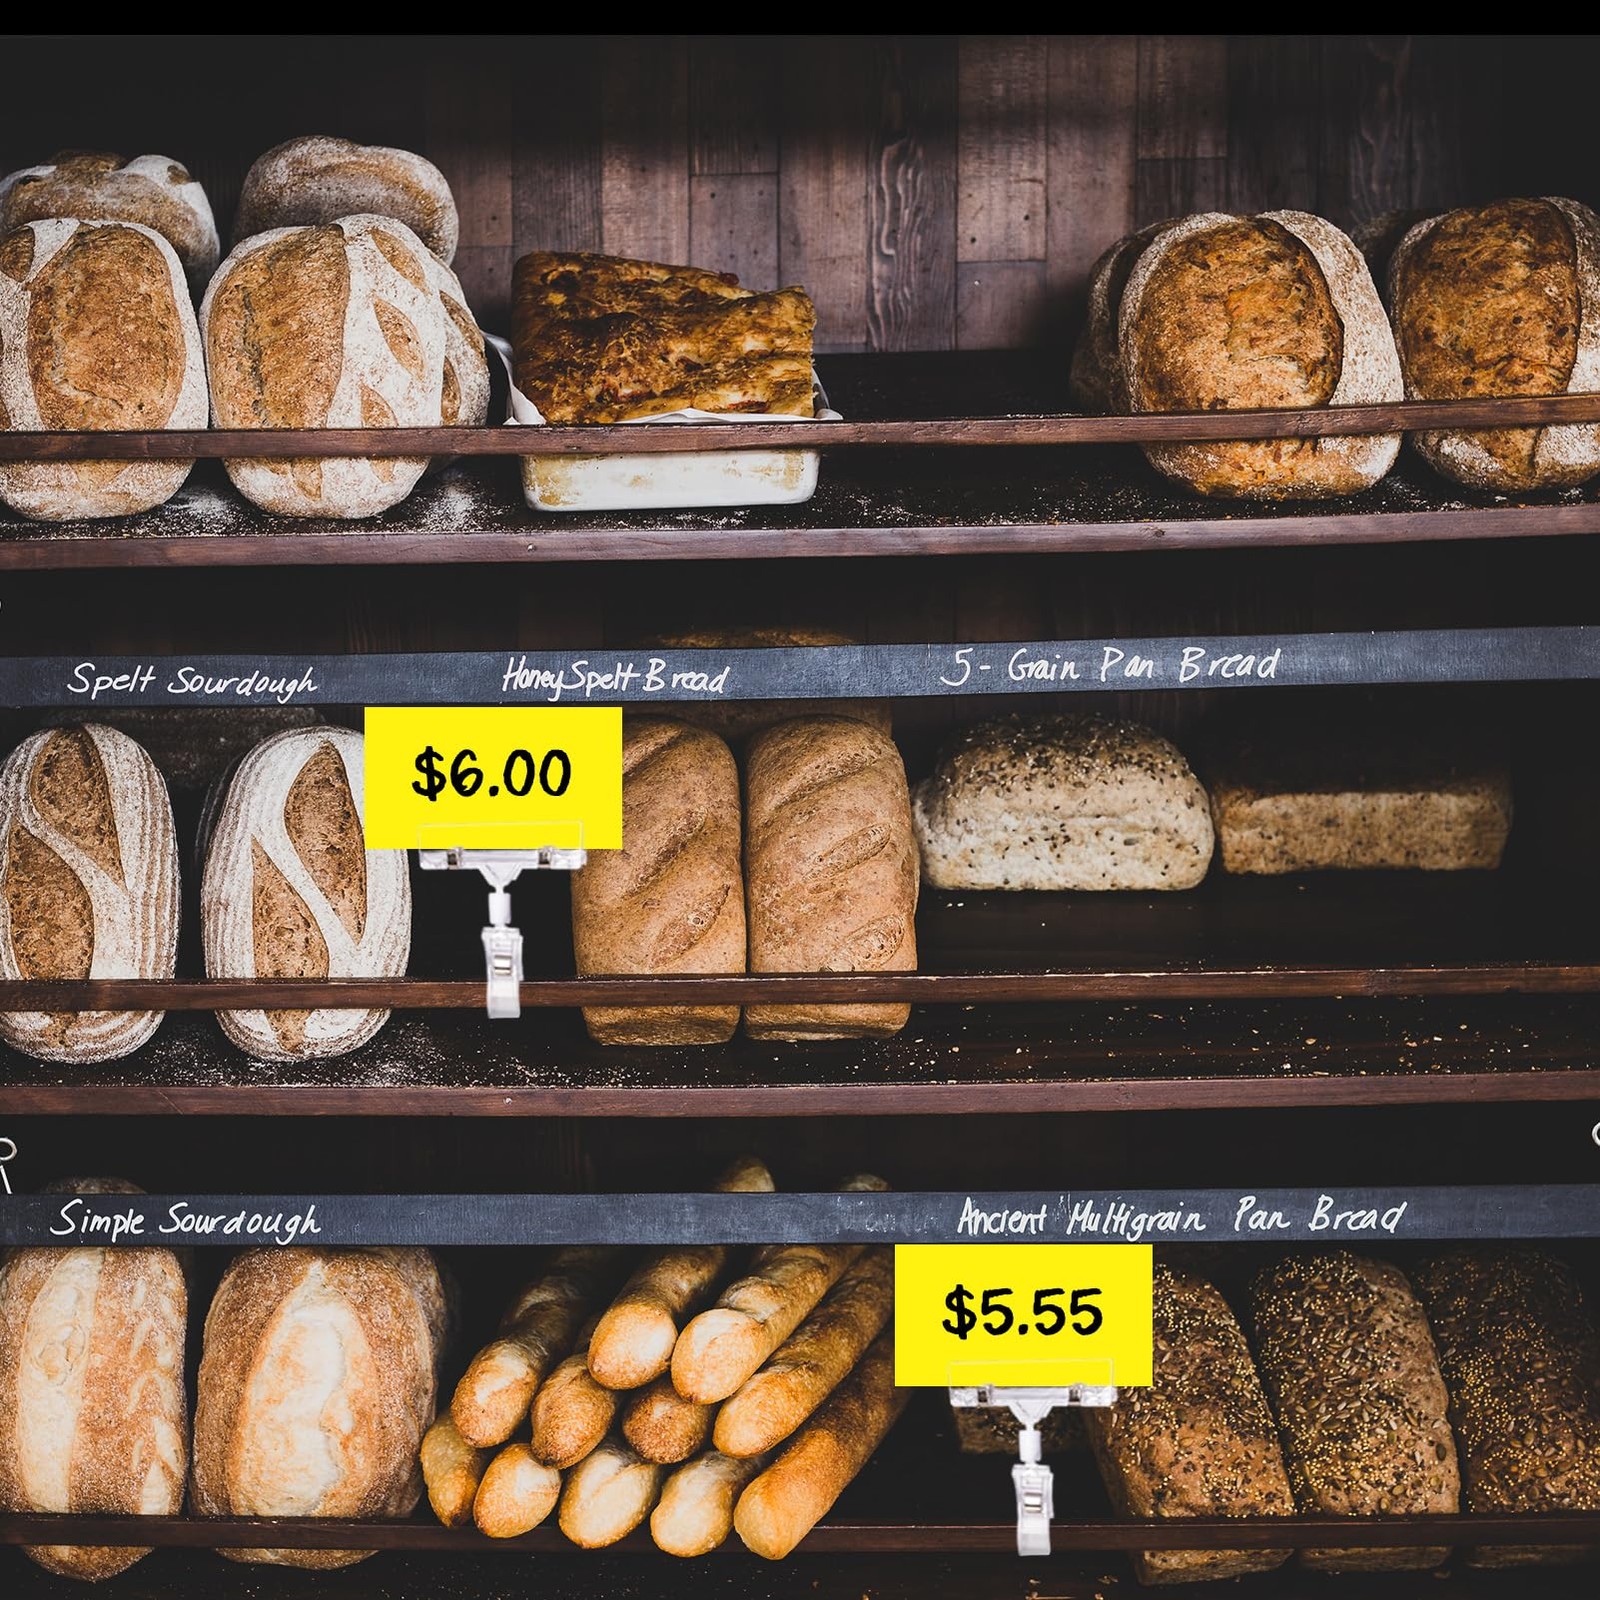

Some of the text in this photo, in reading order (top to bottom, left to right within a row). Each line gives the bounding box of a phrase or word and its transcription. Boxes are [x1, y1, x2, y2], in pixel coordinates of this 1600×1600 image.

[66, 662, 318, 704] Spelt Sourdough
[502, 655, 731, 702] Honey Spelt Bread
[1100, 646, 1153, 682] Pan
[1179, 646, 1282, 683] Bread
[411, 745, 572, 802] $6.00
[50, 1198, 321, 1245] Simple Sourdough
[957, 1194, 1408, 1242] Ancient Multigrain Pan Bread
[942, 1283, 1103, 1341] $5.55
